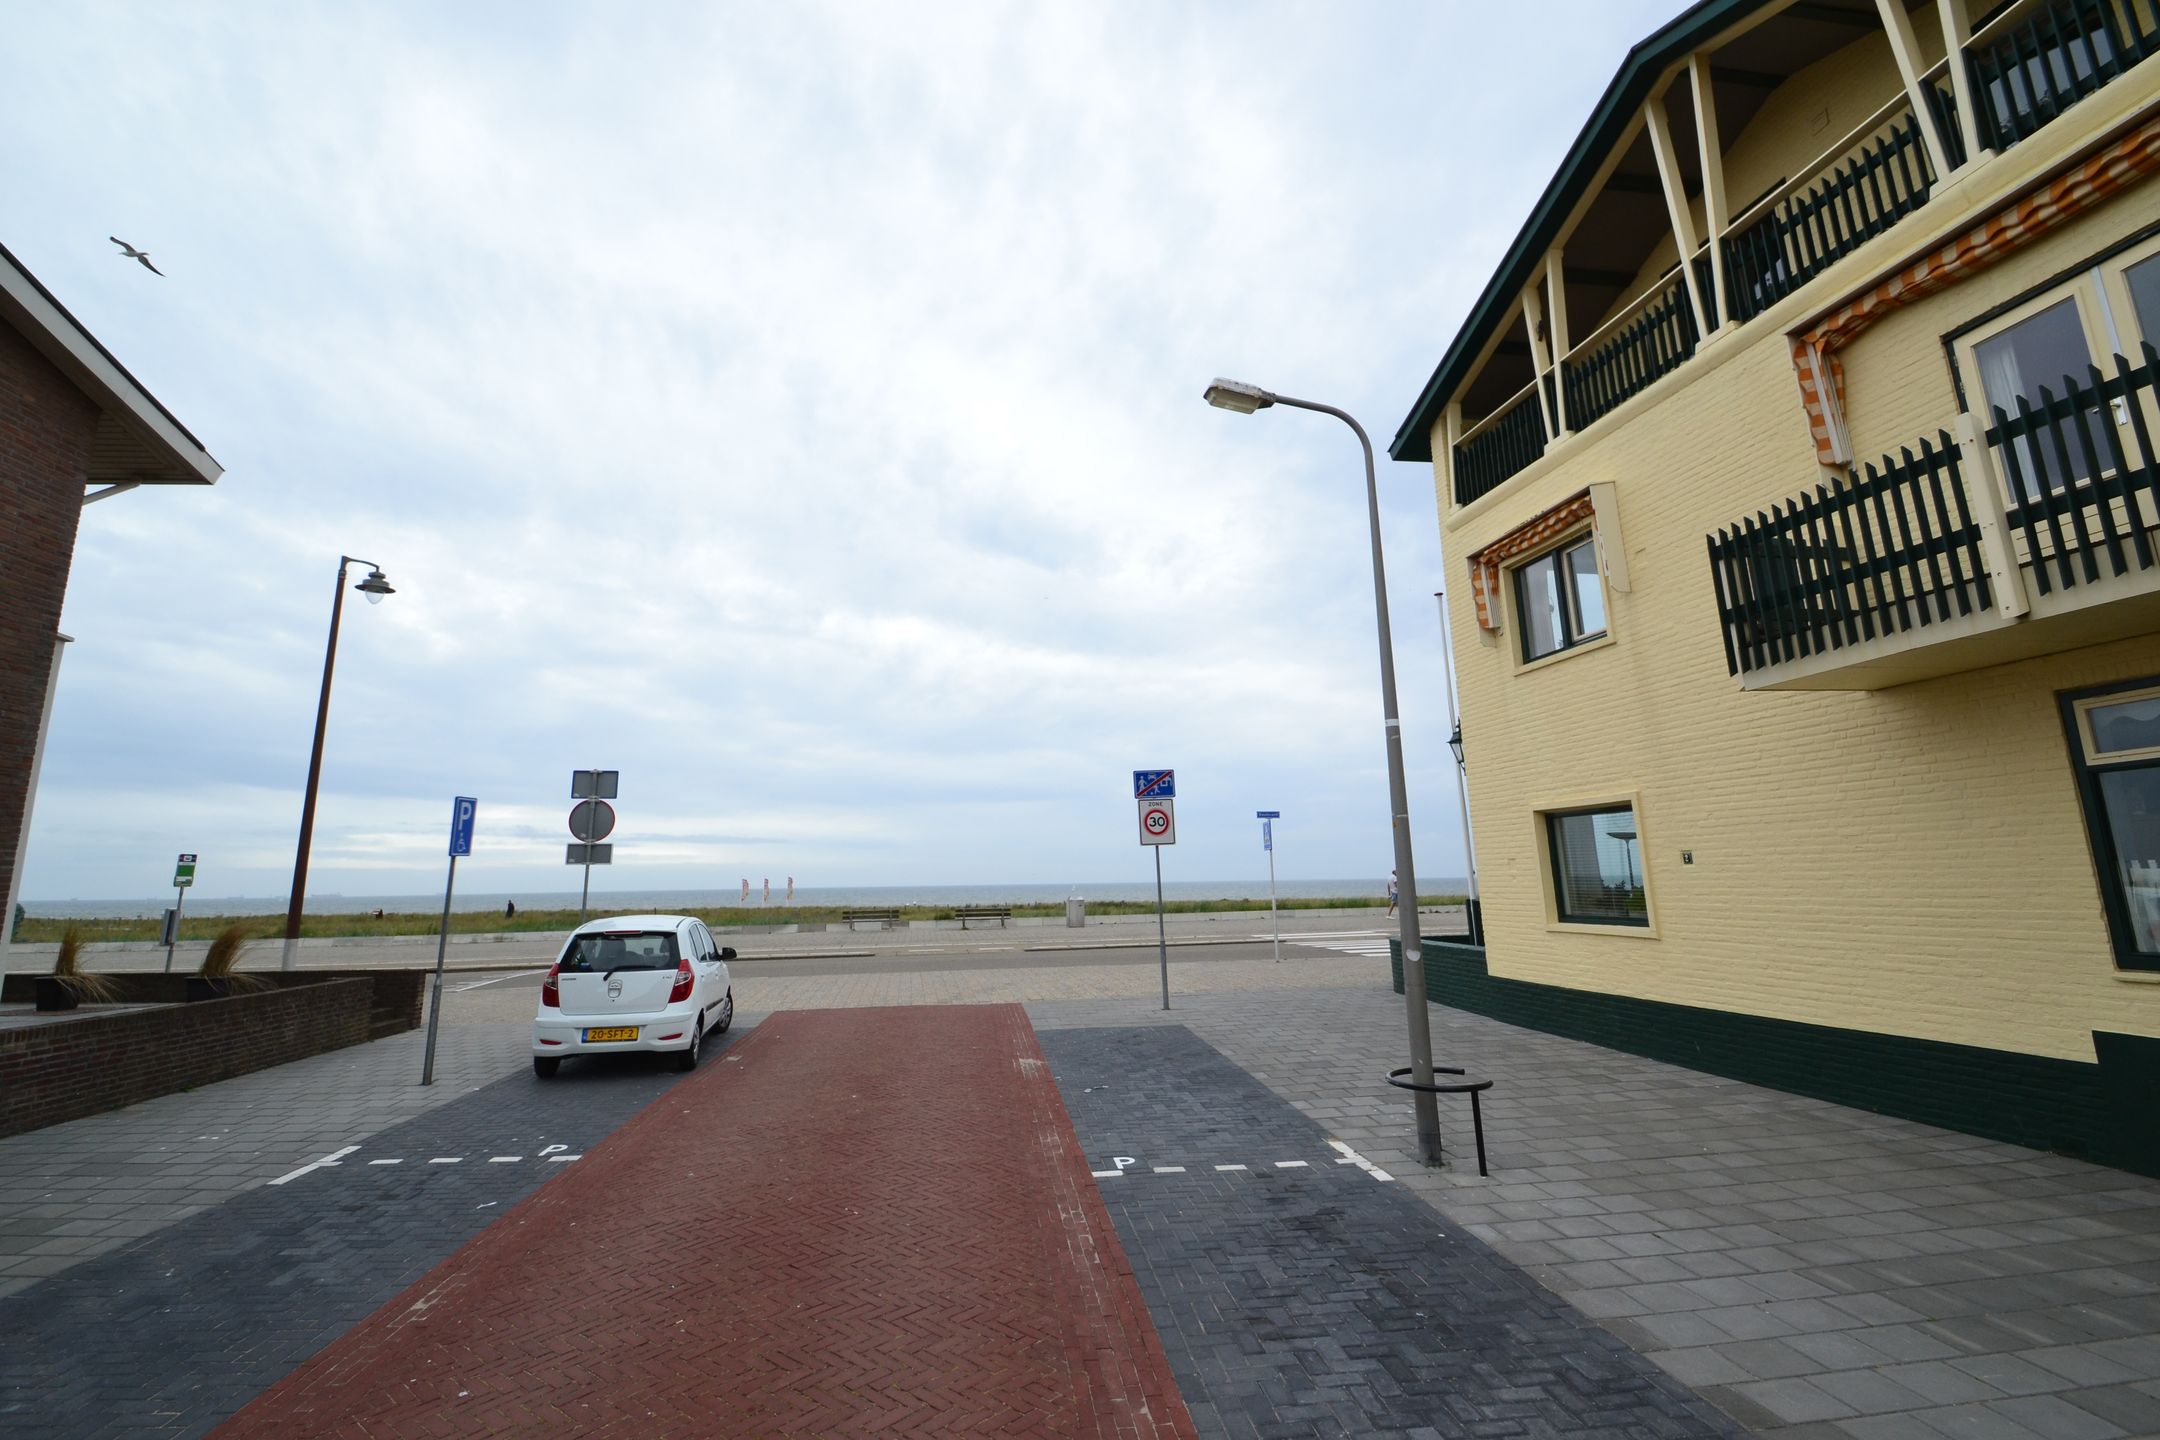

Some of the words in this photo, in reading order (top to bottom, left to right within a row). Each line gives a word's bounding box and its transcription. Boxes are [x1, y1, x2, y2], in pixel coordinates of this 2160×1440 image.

[458, 801, 472, 830] P
[1149, 816, 1166, 827] 30
[591, 1029, 634, 1040] 20-SFT-2
[538, 1144, 569, 1157] P
[1113, 1156, 1136, 1169] P
